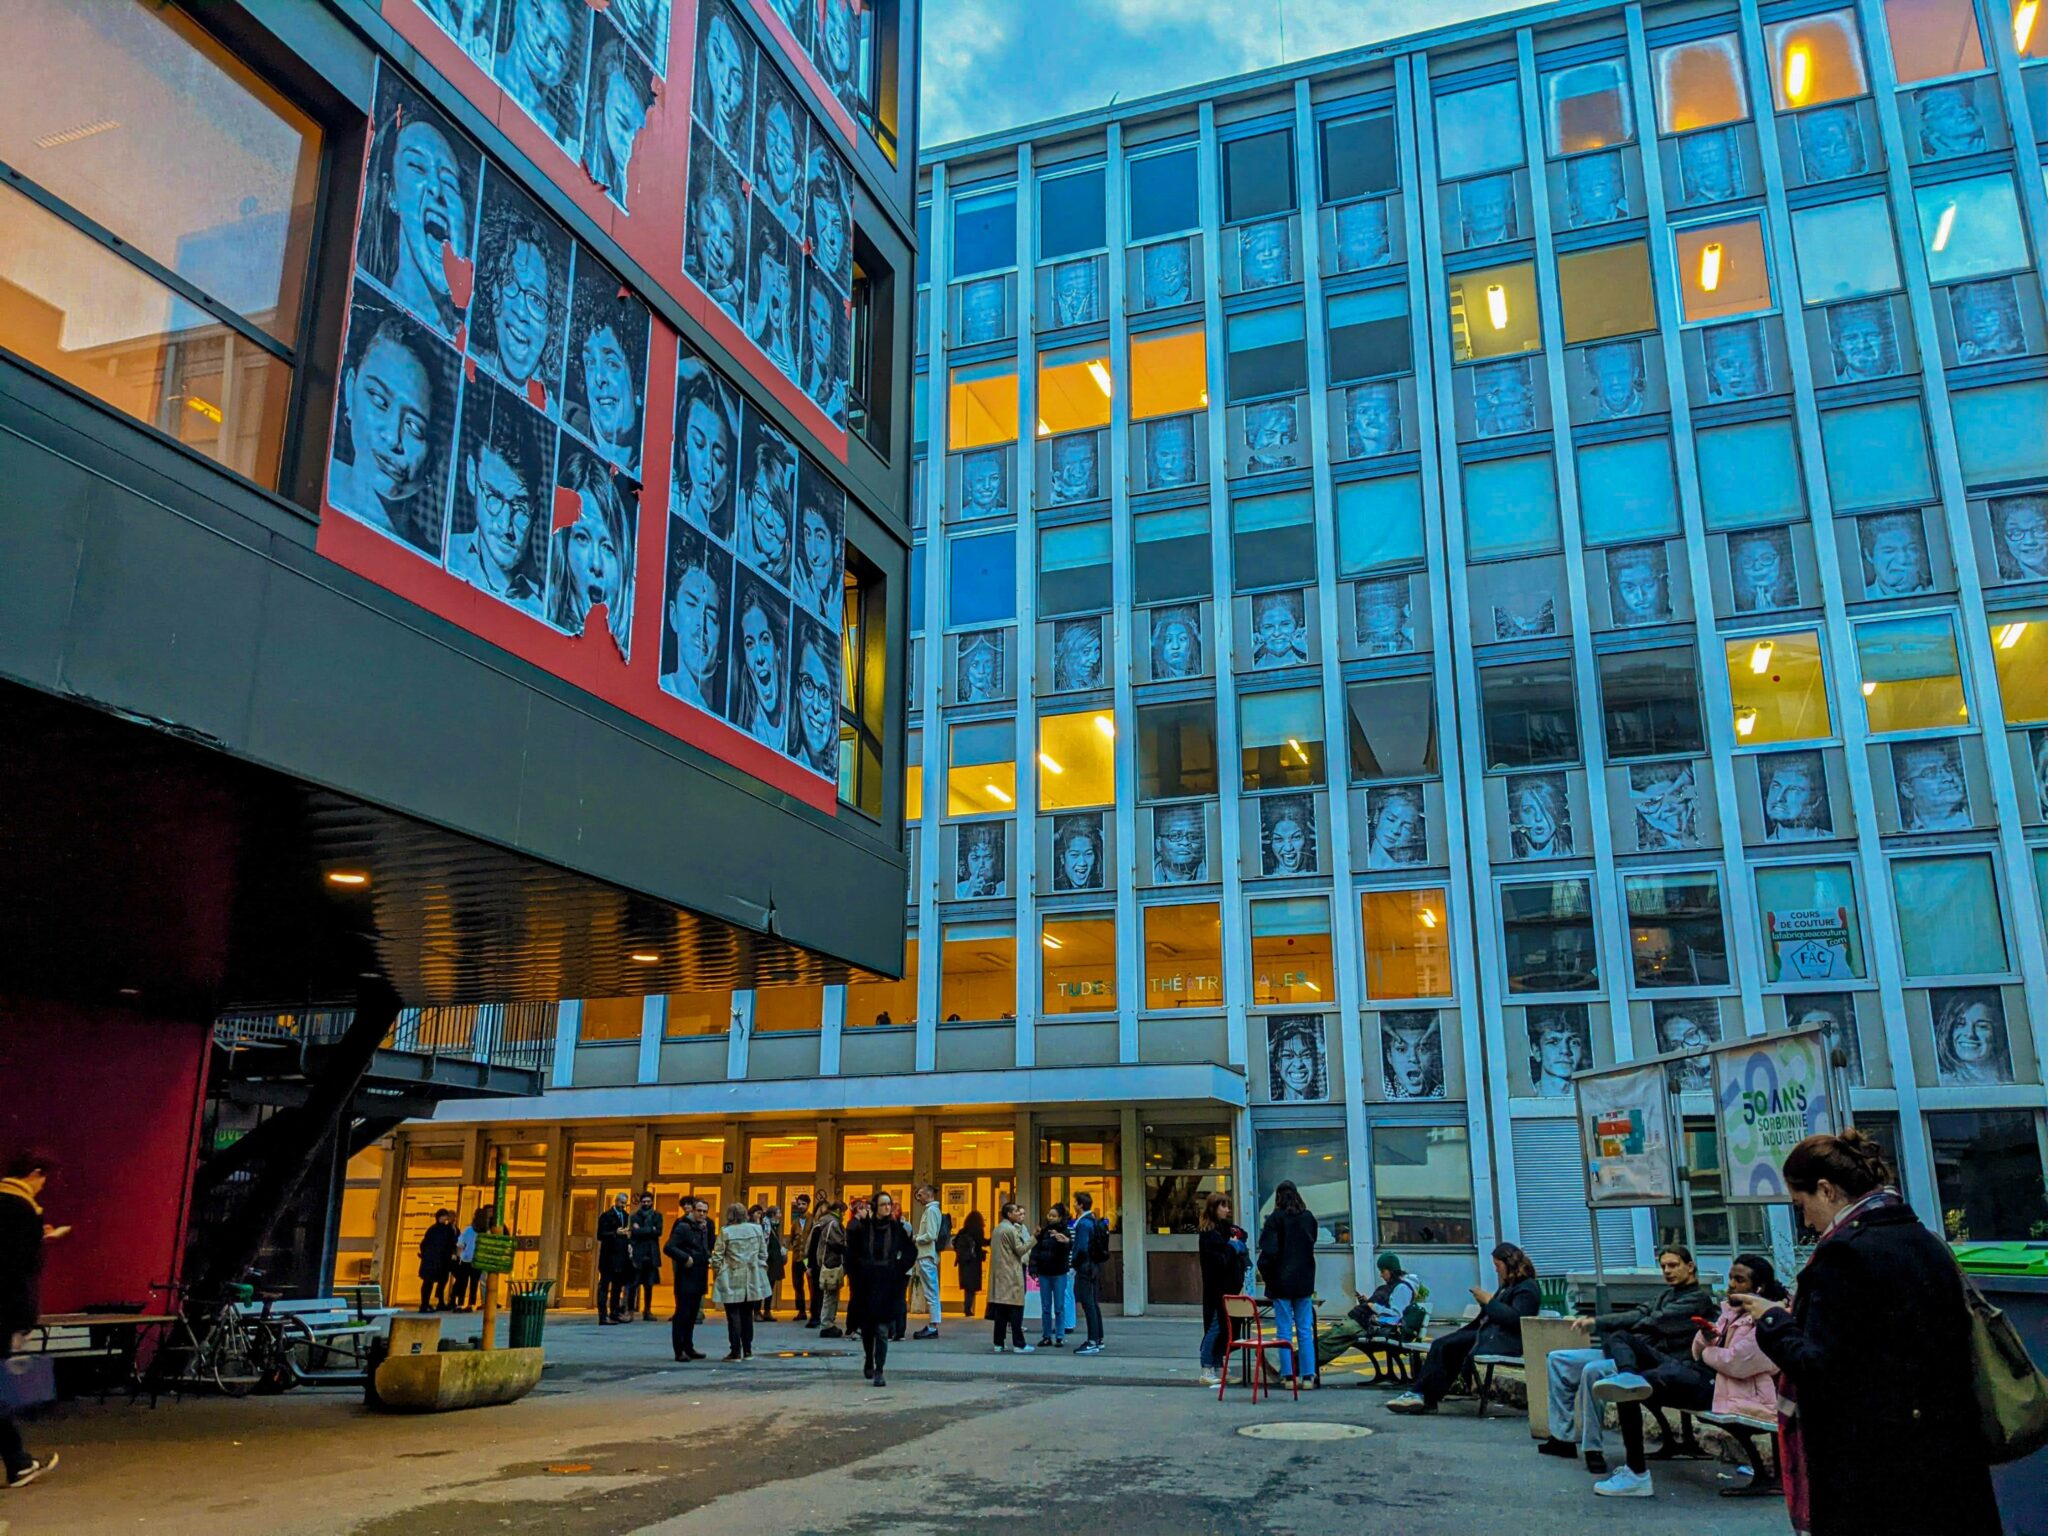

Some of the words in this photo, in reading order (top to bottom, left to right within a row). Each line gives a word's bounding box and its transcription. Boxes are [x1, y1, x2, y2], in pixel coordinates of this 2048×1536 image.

[1790, 911, 1820, 919] COURS
[1780, 921, 1791, 929] DE
[1794, 918, 1836, 928] COUTURE
[1800, 951, 1826, 964] FAC
[1743, 1090, 1767, 1126] 50
[1772, 1084, 1807, 1114] ANS
[1757, 1113, 1808, 1132] SORBONNE
